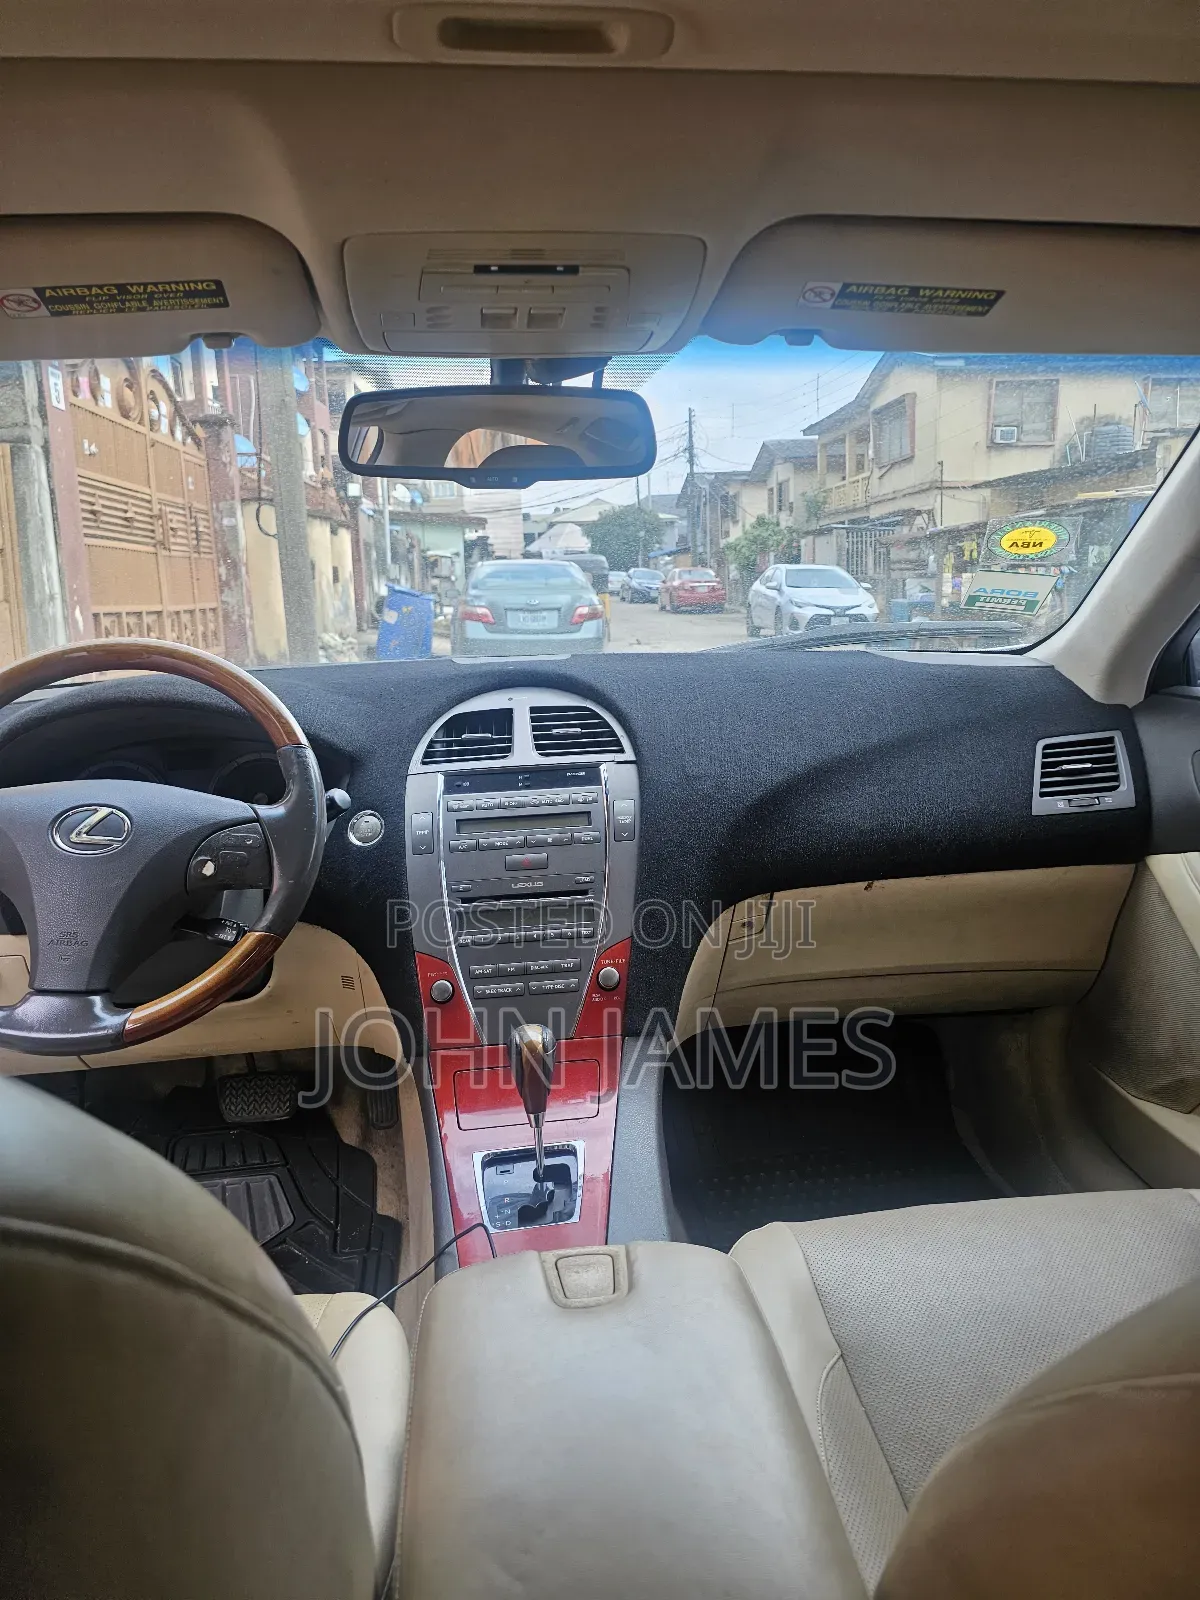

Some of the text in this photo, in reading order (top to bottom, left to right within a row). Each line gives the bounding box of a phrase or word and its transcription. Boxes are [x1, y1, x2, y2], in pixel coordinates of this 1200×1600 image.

[45, 281, 217, 298] AIRBAG WARNING
[845, 285, 997, 299] AIRBAG WARNING
[511, 881, 544, 889] LEXUS
